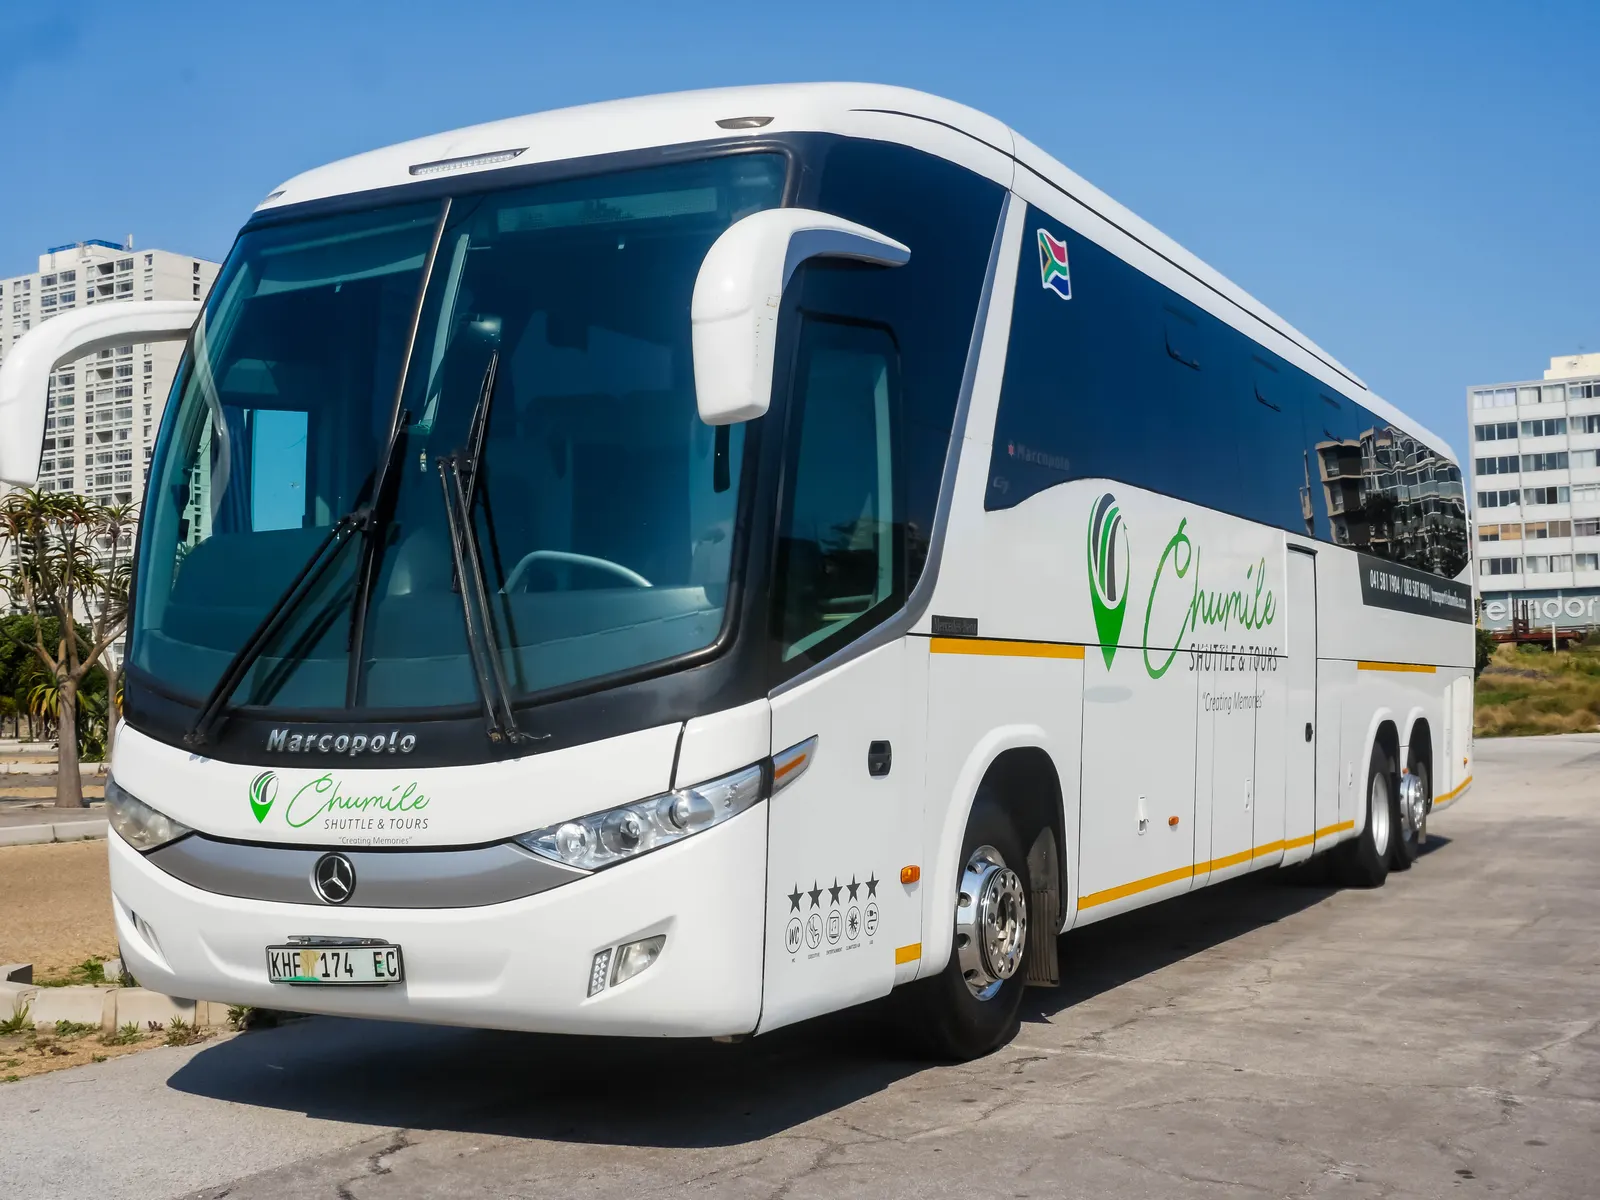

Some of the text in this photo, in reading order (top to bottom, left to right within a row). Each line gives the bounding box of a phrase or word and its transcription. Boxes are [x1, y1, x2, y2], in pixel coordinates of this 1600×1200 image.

[1143, 517, 1277, 680] Chumile
[1189, 643, 1236, 672] SHUTTLE
[1248, 646, 1278, 671] TOURS
[266, 728, 417, 756] Marcopolo
[285, 772, 431, 829] Chumile
[324, 818, 429, 830] SHUTTLE & TOURS
[320, 952, 354, 977] 174
[373, 951, 397, 977] EC
